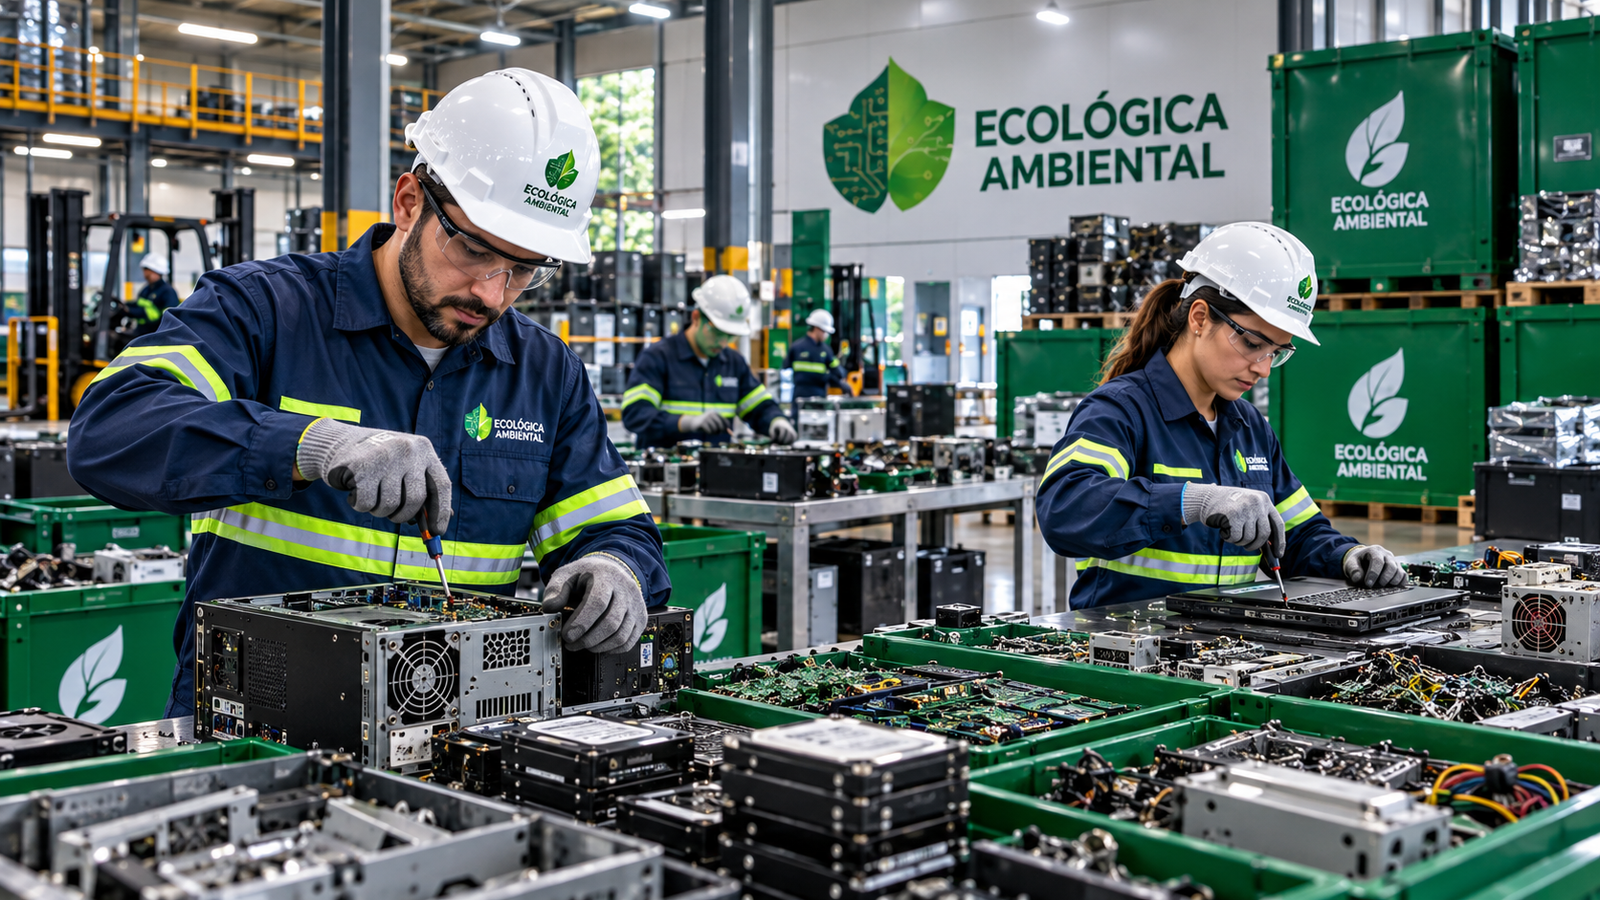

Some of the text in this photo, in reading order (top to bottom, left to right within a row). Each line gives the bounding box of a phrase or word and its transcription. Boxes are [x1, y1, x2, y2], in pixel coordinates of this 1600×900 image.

[975, 90, 1229, 147] ECOLÓGICA
[979, 142, 1226, 192] AMBIENTAL
[523, 183, 577, 210] ECOLÓGICA
[523, 196, 569, 218] AMBIENTAL
[1331, 189, 1429, 213] ECOLÓGICA
[1333, 210, 1428, 231] AMBIENTAL
[494, 417, 545, 433] ECOLÓGICA
[495, 429, 544, 443] AMBIENTAL
[1334, 441, 1429, 464] ECOLÓGICA
[1336, 461, 1428, 481] AMBIENTAL
